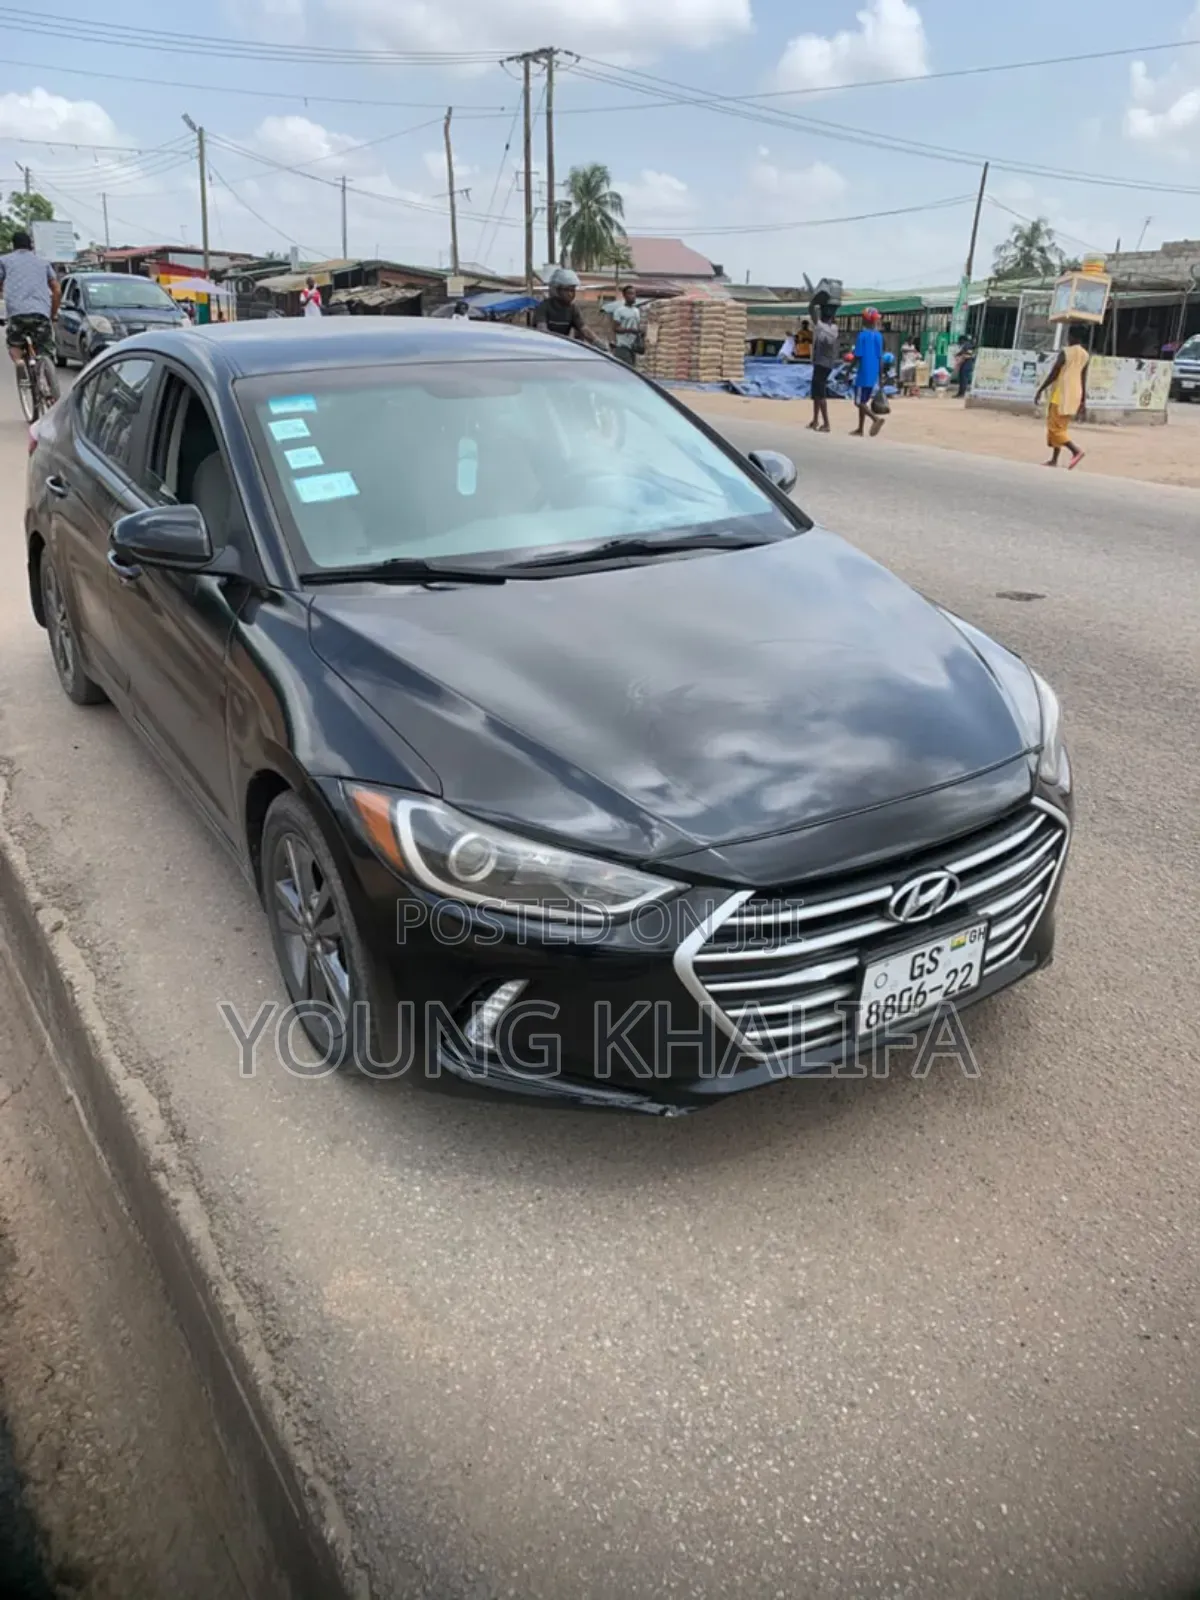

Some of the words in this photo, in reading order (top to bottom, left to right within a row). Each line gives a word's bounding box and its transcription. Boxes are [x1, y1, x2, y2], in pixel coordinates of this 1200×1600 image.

[968, 926, 986, 944] GH
[909, 946, 943, 981] GS
[865, 962, 974, 1030] 8806-22
